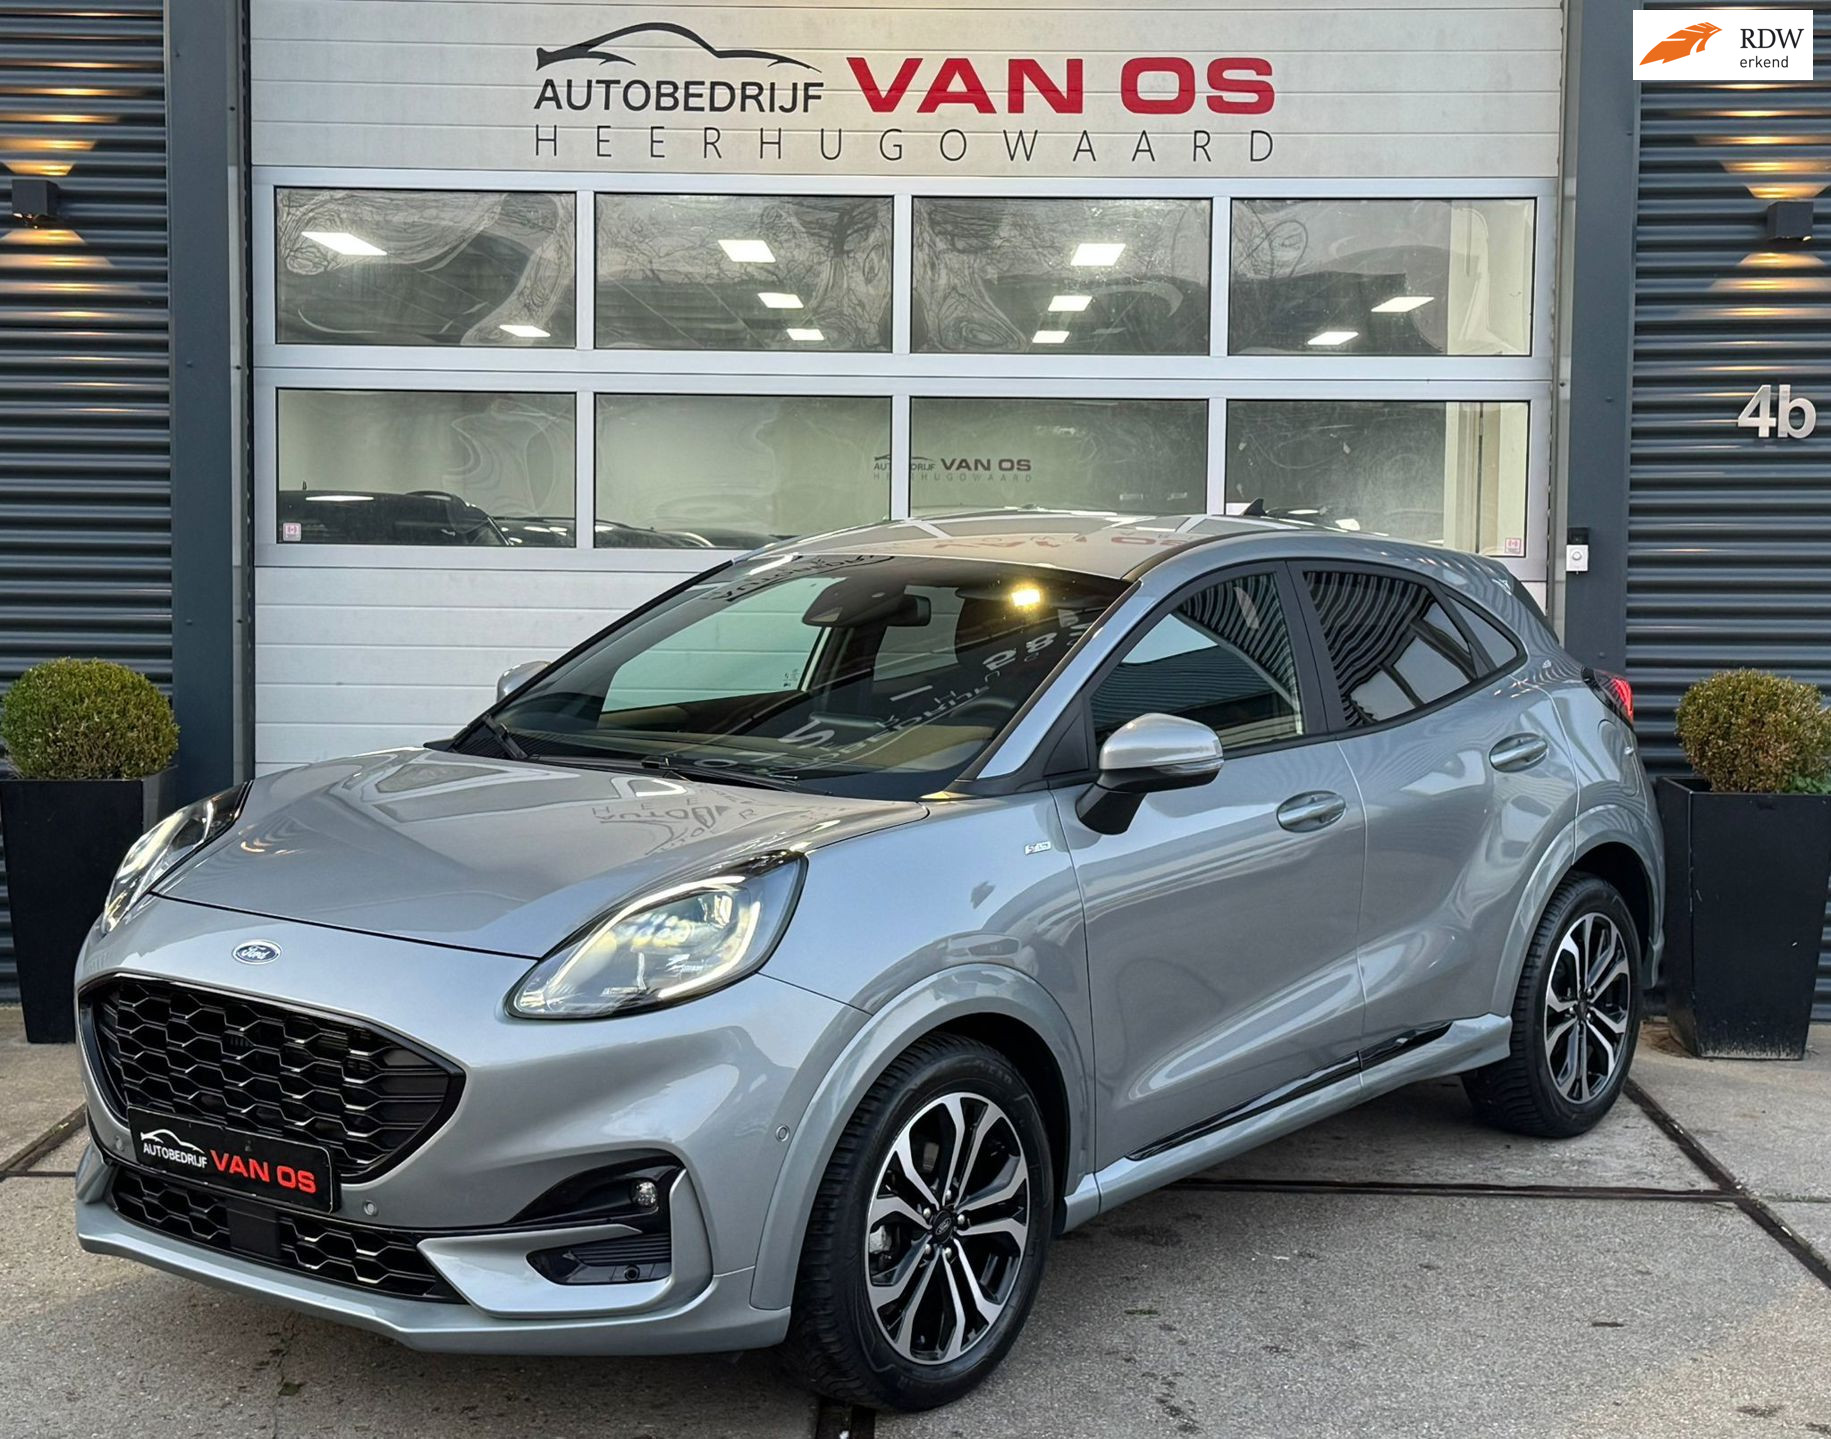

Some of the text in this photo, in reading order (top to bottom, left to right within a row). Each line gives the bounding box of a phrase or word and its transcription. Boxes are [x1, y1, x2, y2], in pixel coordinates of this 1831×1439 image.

[534, 57, 1275, 115] AUTOBEDRIJF VAN OS
[535, 125, 1274, 161] HEERHUGOWAARD
[1738, 384, 1816, 438] 4b
[941, 458, 991, 471] VAN
[998, 459, 1031, 471] OS
[143, 1142, 317, 1194] AUTOBEDRIJF VAN OS
